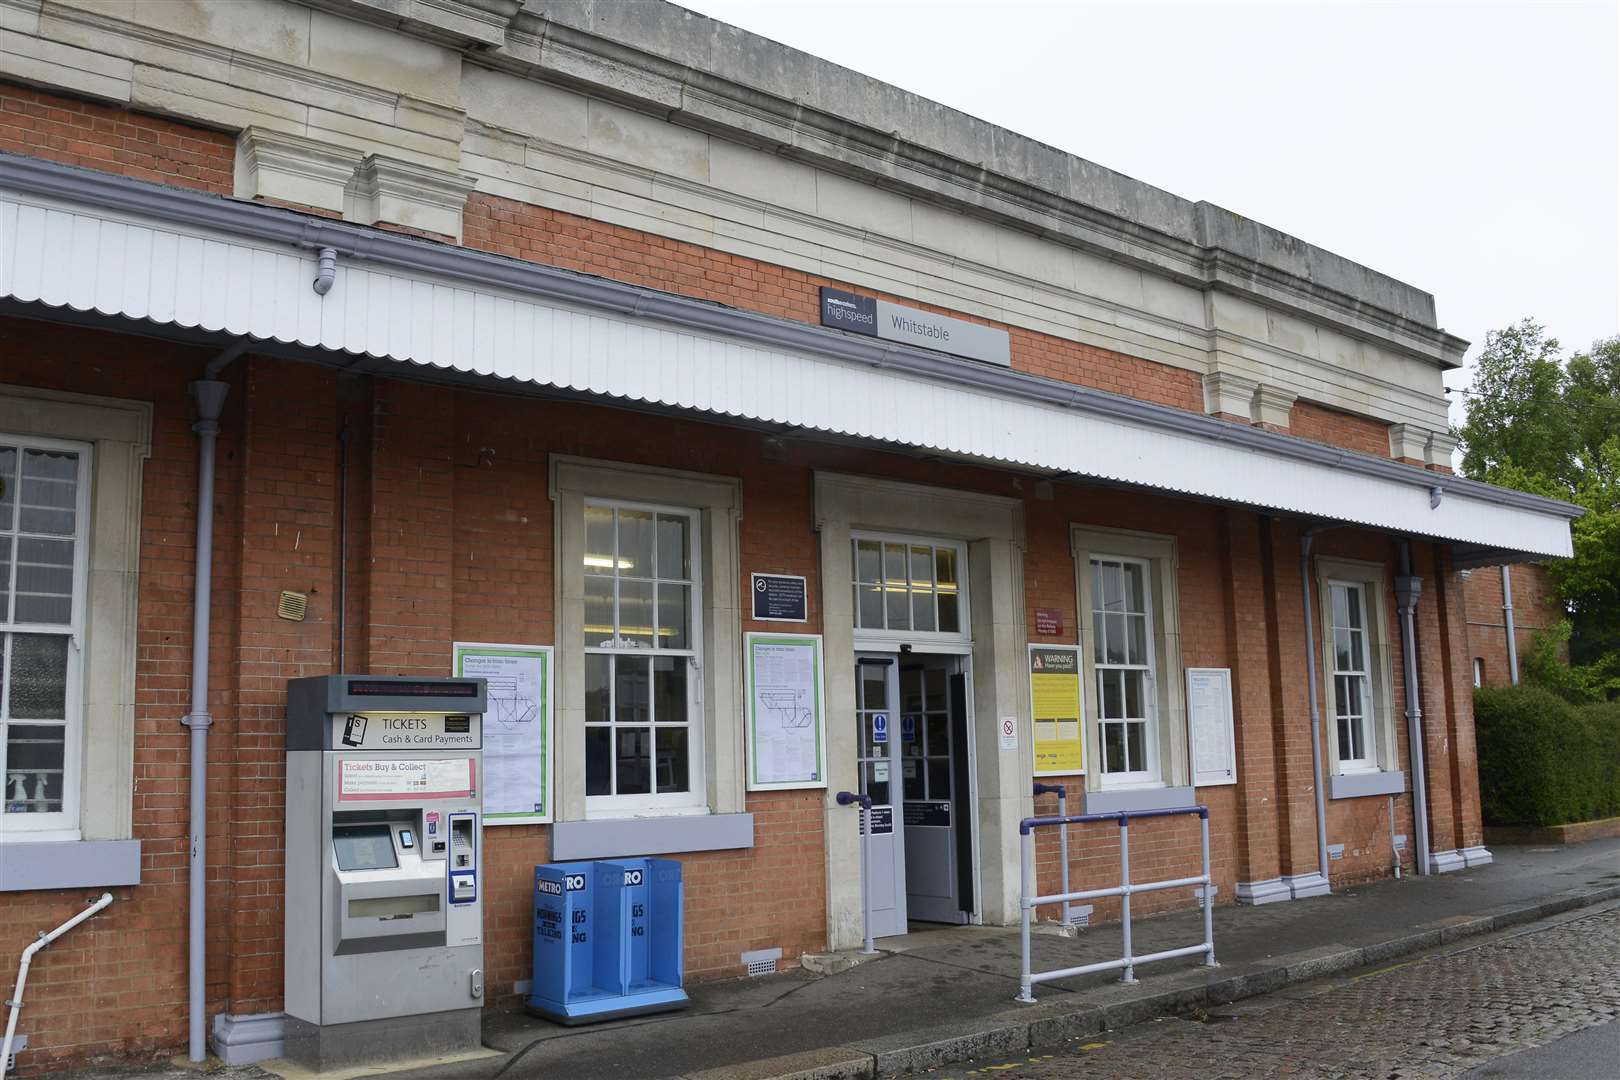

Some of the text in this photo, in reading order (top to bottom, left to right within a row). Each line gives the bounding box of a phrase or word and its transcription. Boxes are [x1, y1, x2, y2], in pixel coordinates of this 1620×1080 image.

[827, 304, 873, 325] highspeed
[891, 313, 950, 341] Whitstable
[1044, 654, 1073, 663] WARNING
[382, 718, 427, 730] TICKETS
[382, 734, 473, 745] Cash & Card Payments
[344, 762, 426, 773] Tickets Buy & Collect
[538, 880, 561, 894] METRO
[562, 876, 584, 890] RO
